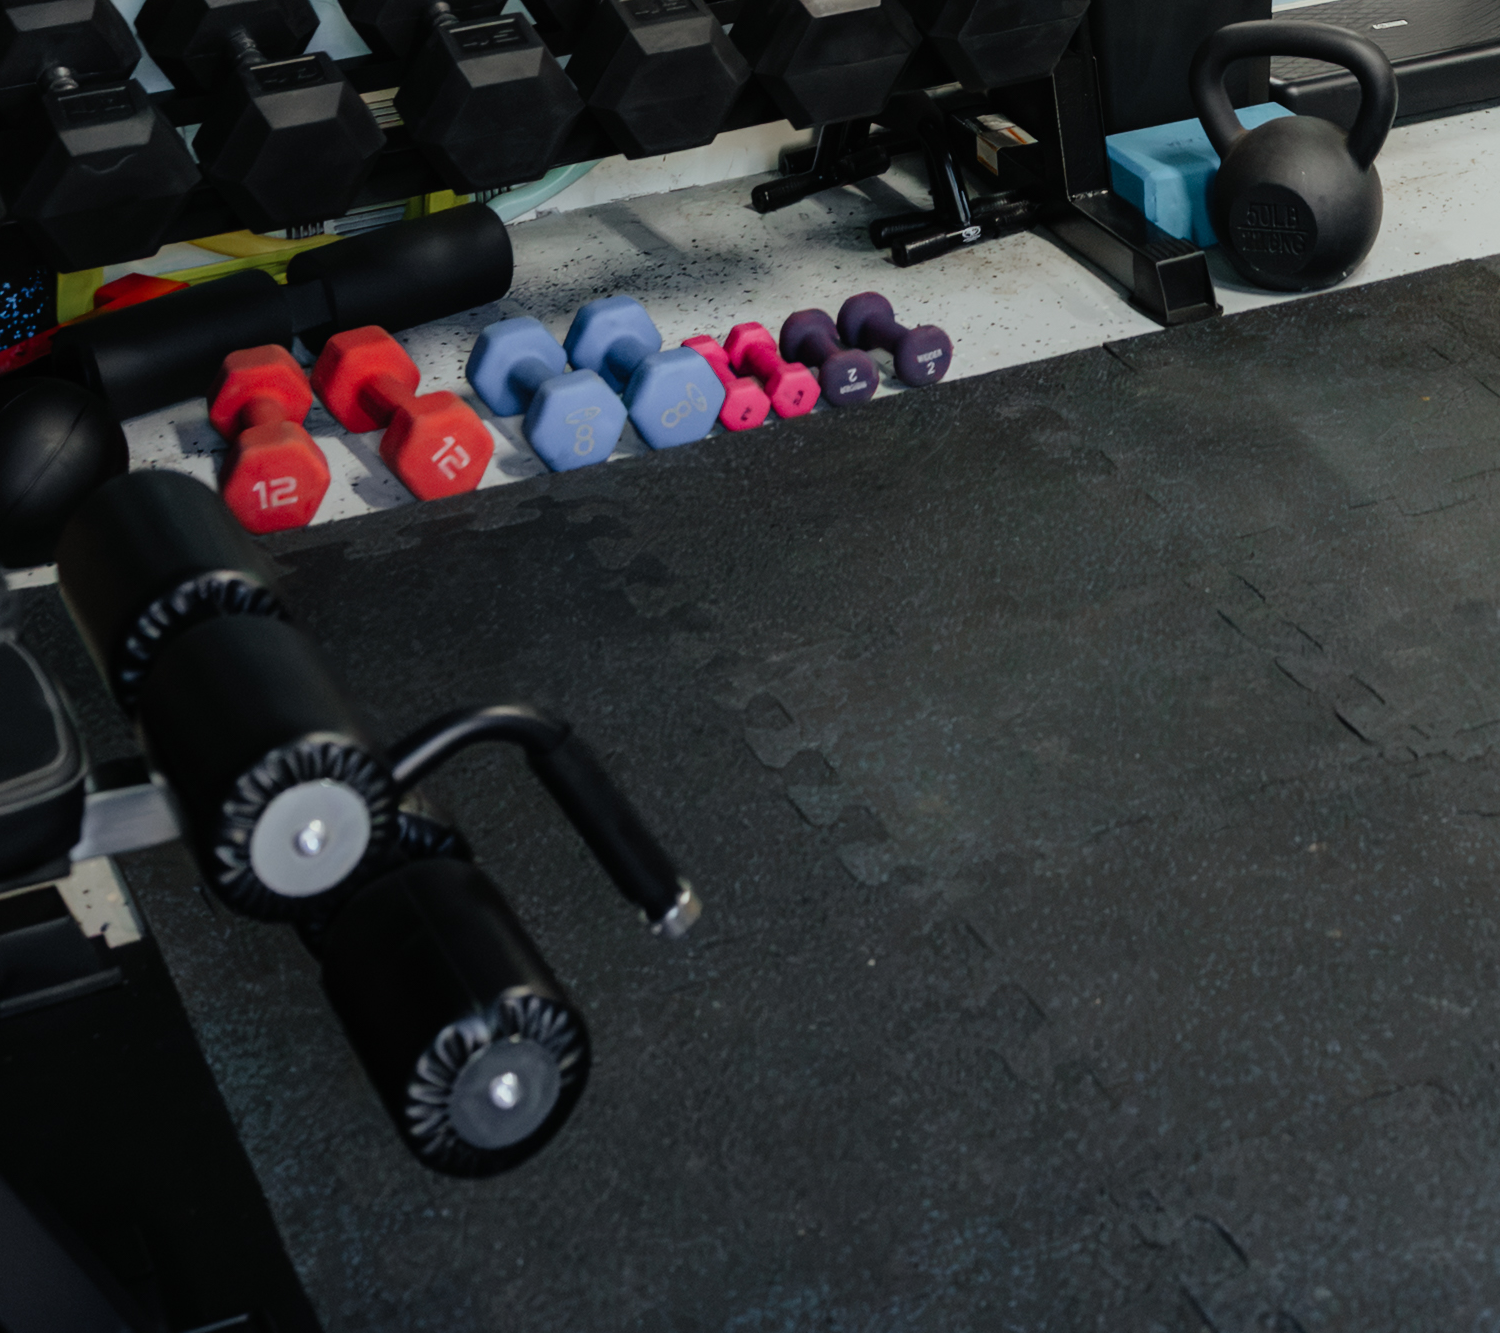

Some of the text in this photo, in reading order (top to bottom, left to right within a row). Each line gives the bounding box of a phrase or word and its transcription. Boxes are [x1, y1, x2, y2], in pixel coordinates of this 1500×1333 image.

[660, 400, 692, 428] 8
[573, 424, 595, 456] 8
[431, 435, 471, 481] 12
[251, 476, 299, 511] 12
